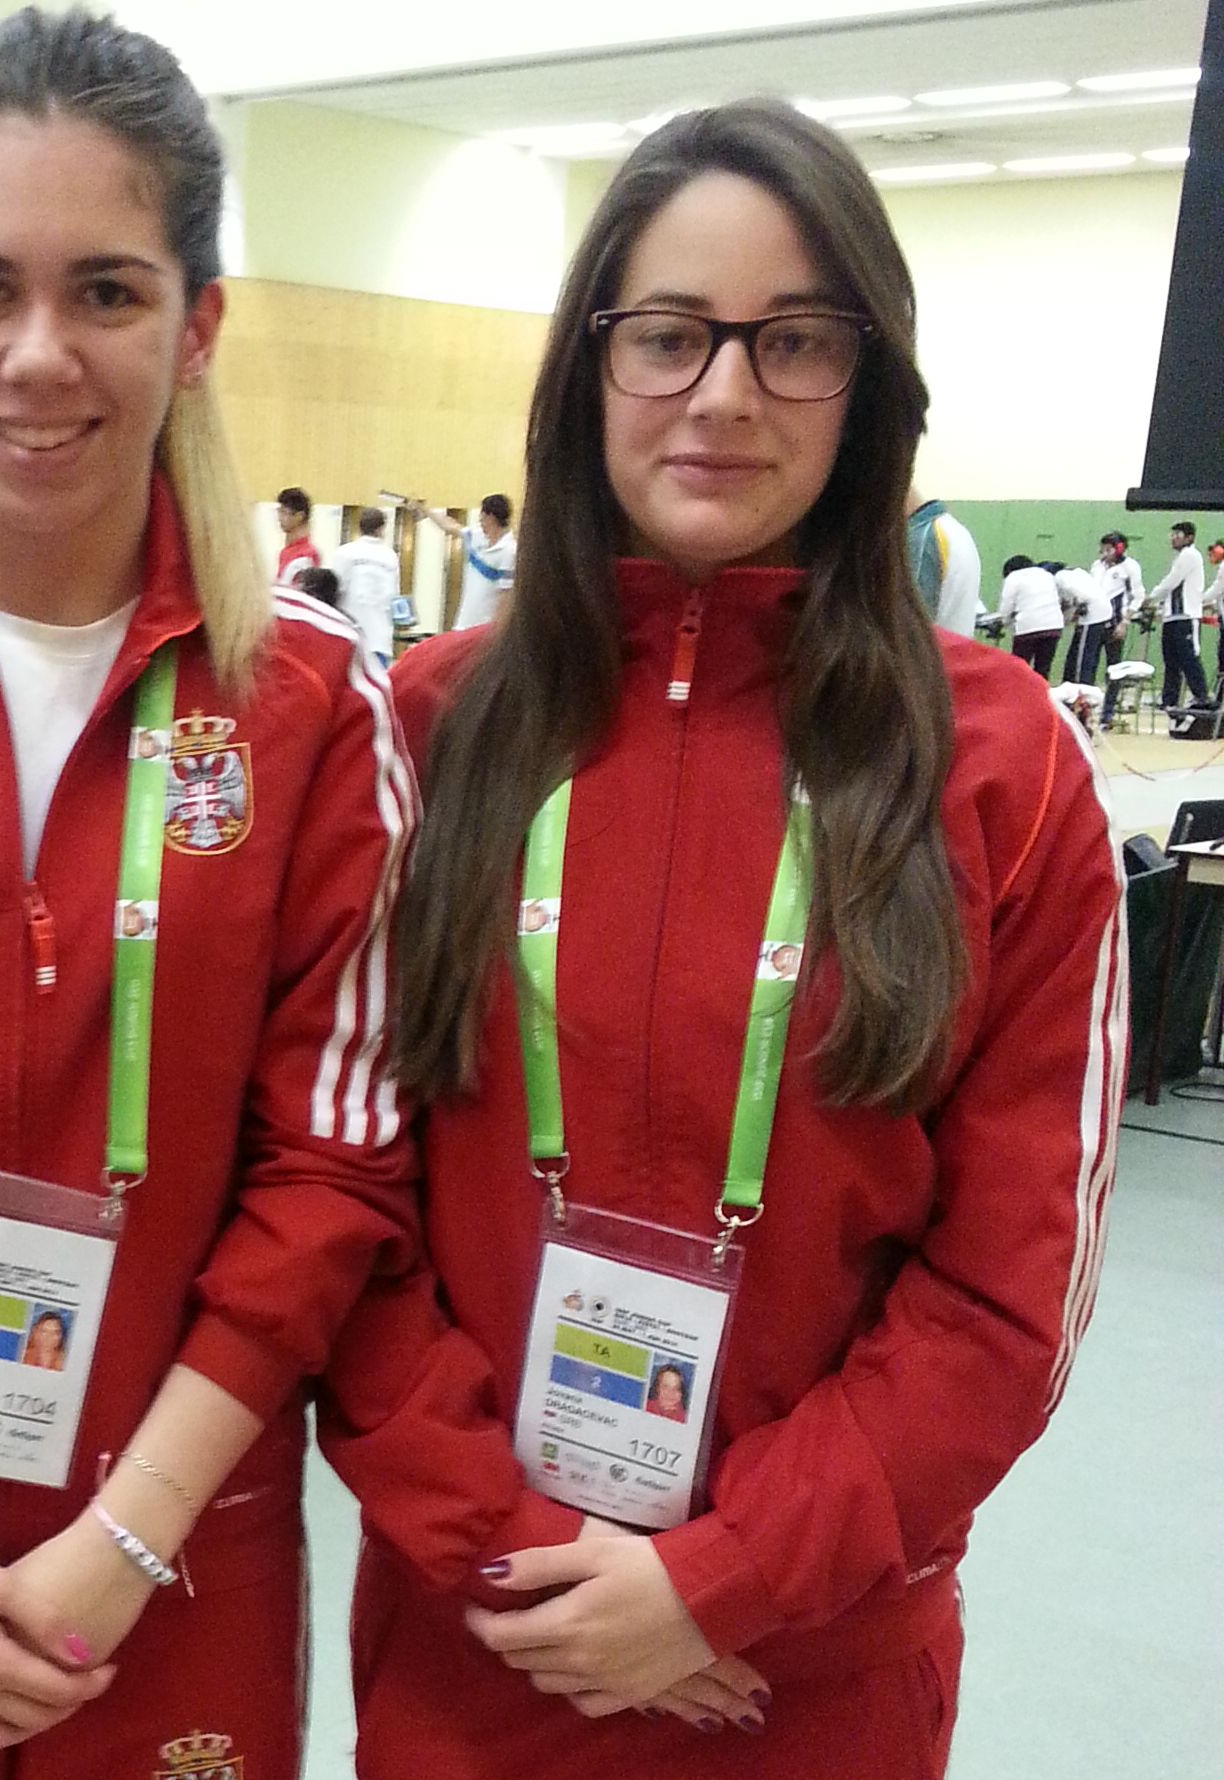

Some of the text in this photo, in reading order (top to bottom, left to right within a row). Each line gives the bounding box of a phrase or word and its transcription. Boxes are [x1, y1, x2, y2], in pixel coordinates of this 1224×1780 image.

[592, 1342, 612, 1359] TA
[590, 1374, 602, 1388] 2
[629, 1438, 683, 1468] 1707
